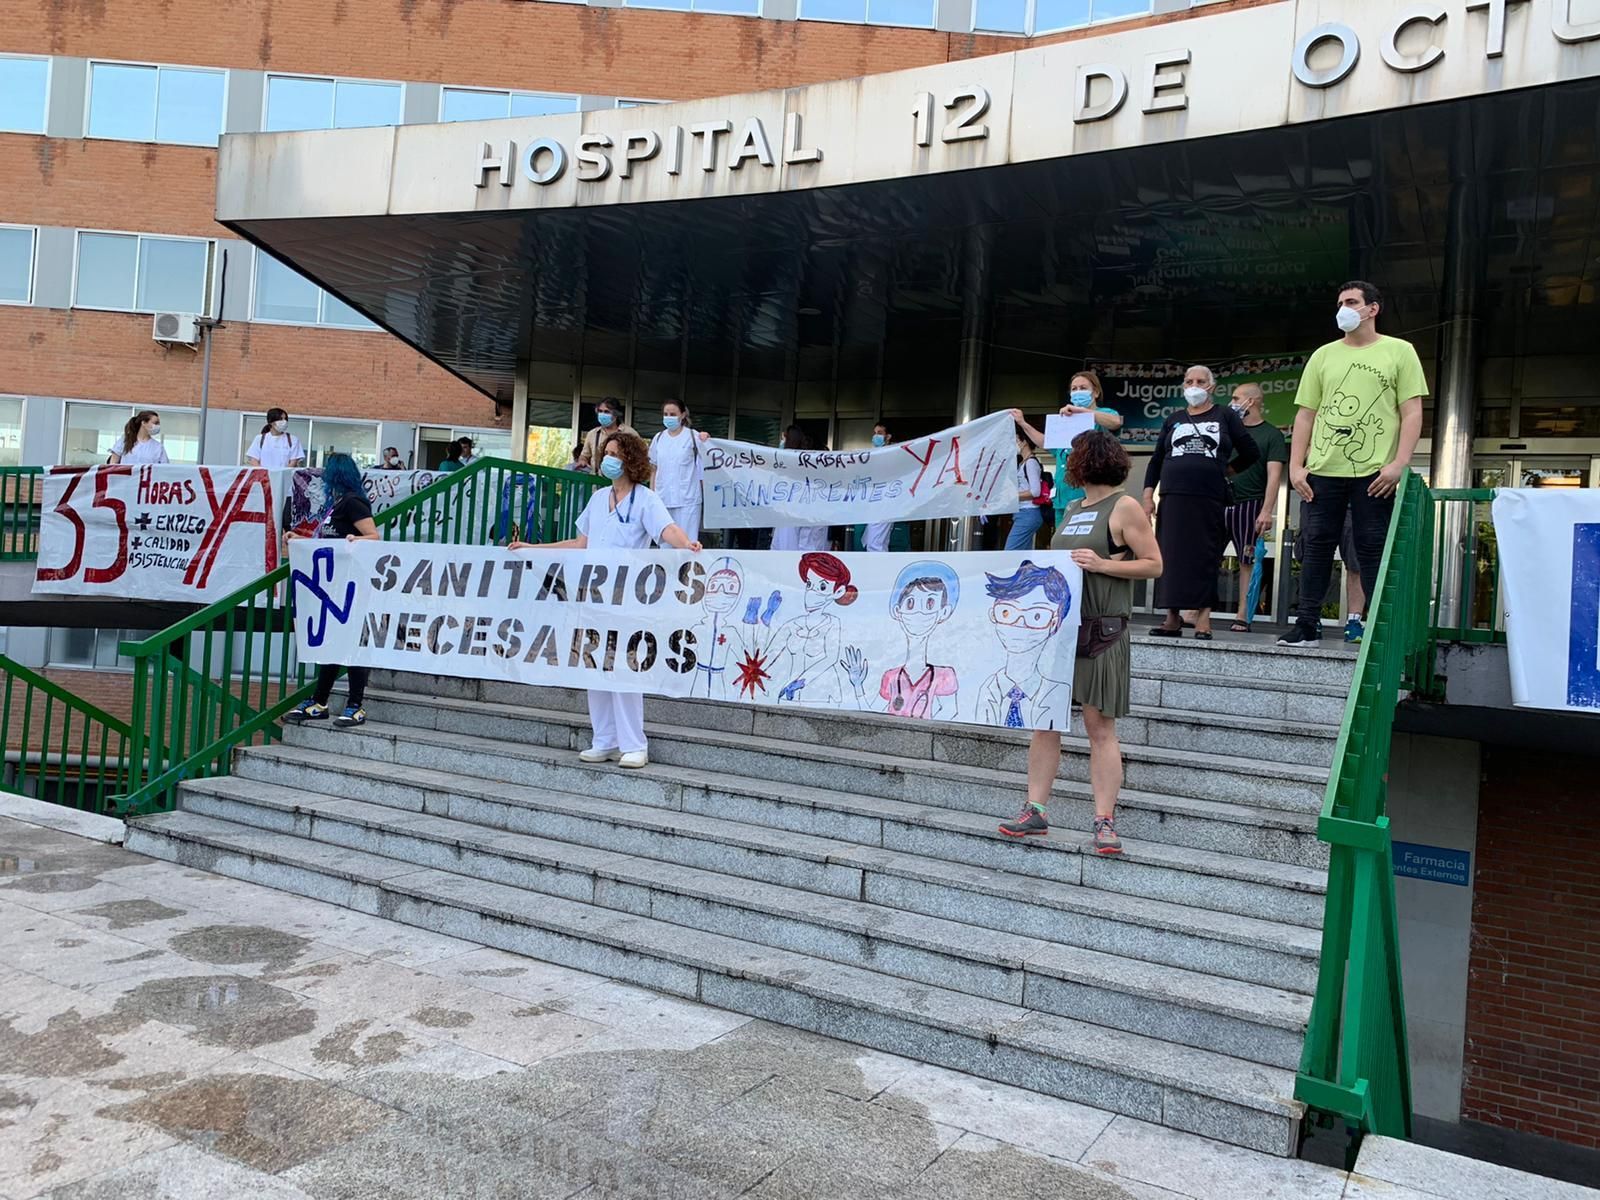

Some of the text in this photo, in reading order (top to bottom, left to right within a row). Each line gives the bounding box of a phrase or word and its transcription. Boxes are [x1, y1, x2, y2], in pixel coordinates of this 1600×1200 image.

[474, 112, 823, 188] HOSPITAL
[911, 83, 990, 148] 12
[1073, 48, 1192, 125] DE
[1116, 380, 1184, 402] Jugam
[714, 475, 904, 508] TRANSPARENTES
[37, 465, 278, 597] 35 HORAS YA
[156, 514, 206, 534] EMPLEO
[144, 536, 190, 552] CALIDAD
[371, 554, 706, 606] SANITARIOS
[359, 612, 697, 674] NECESARIOS
[1404, 852, 1465, 871] Farmacia
